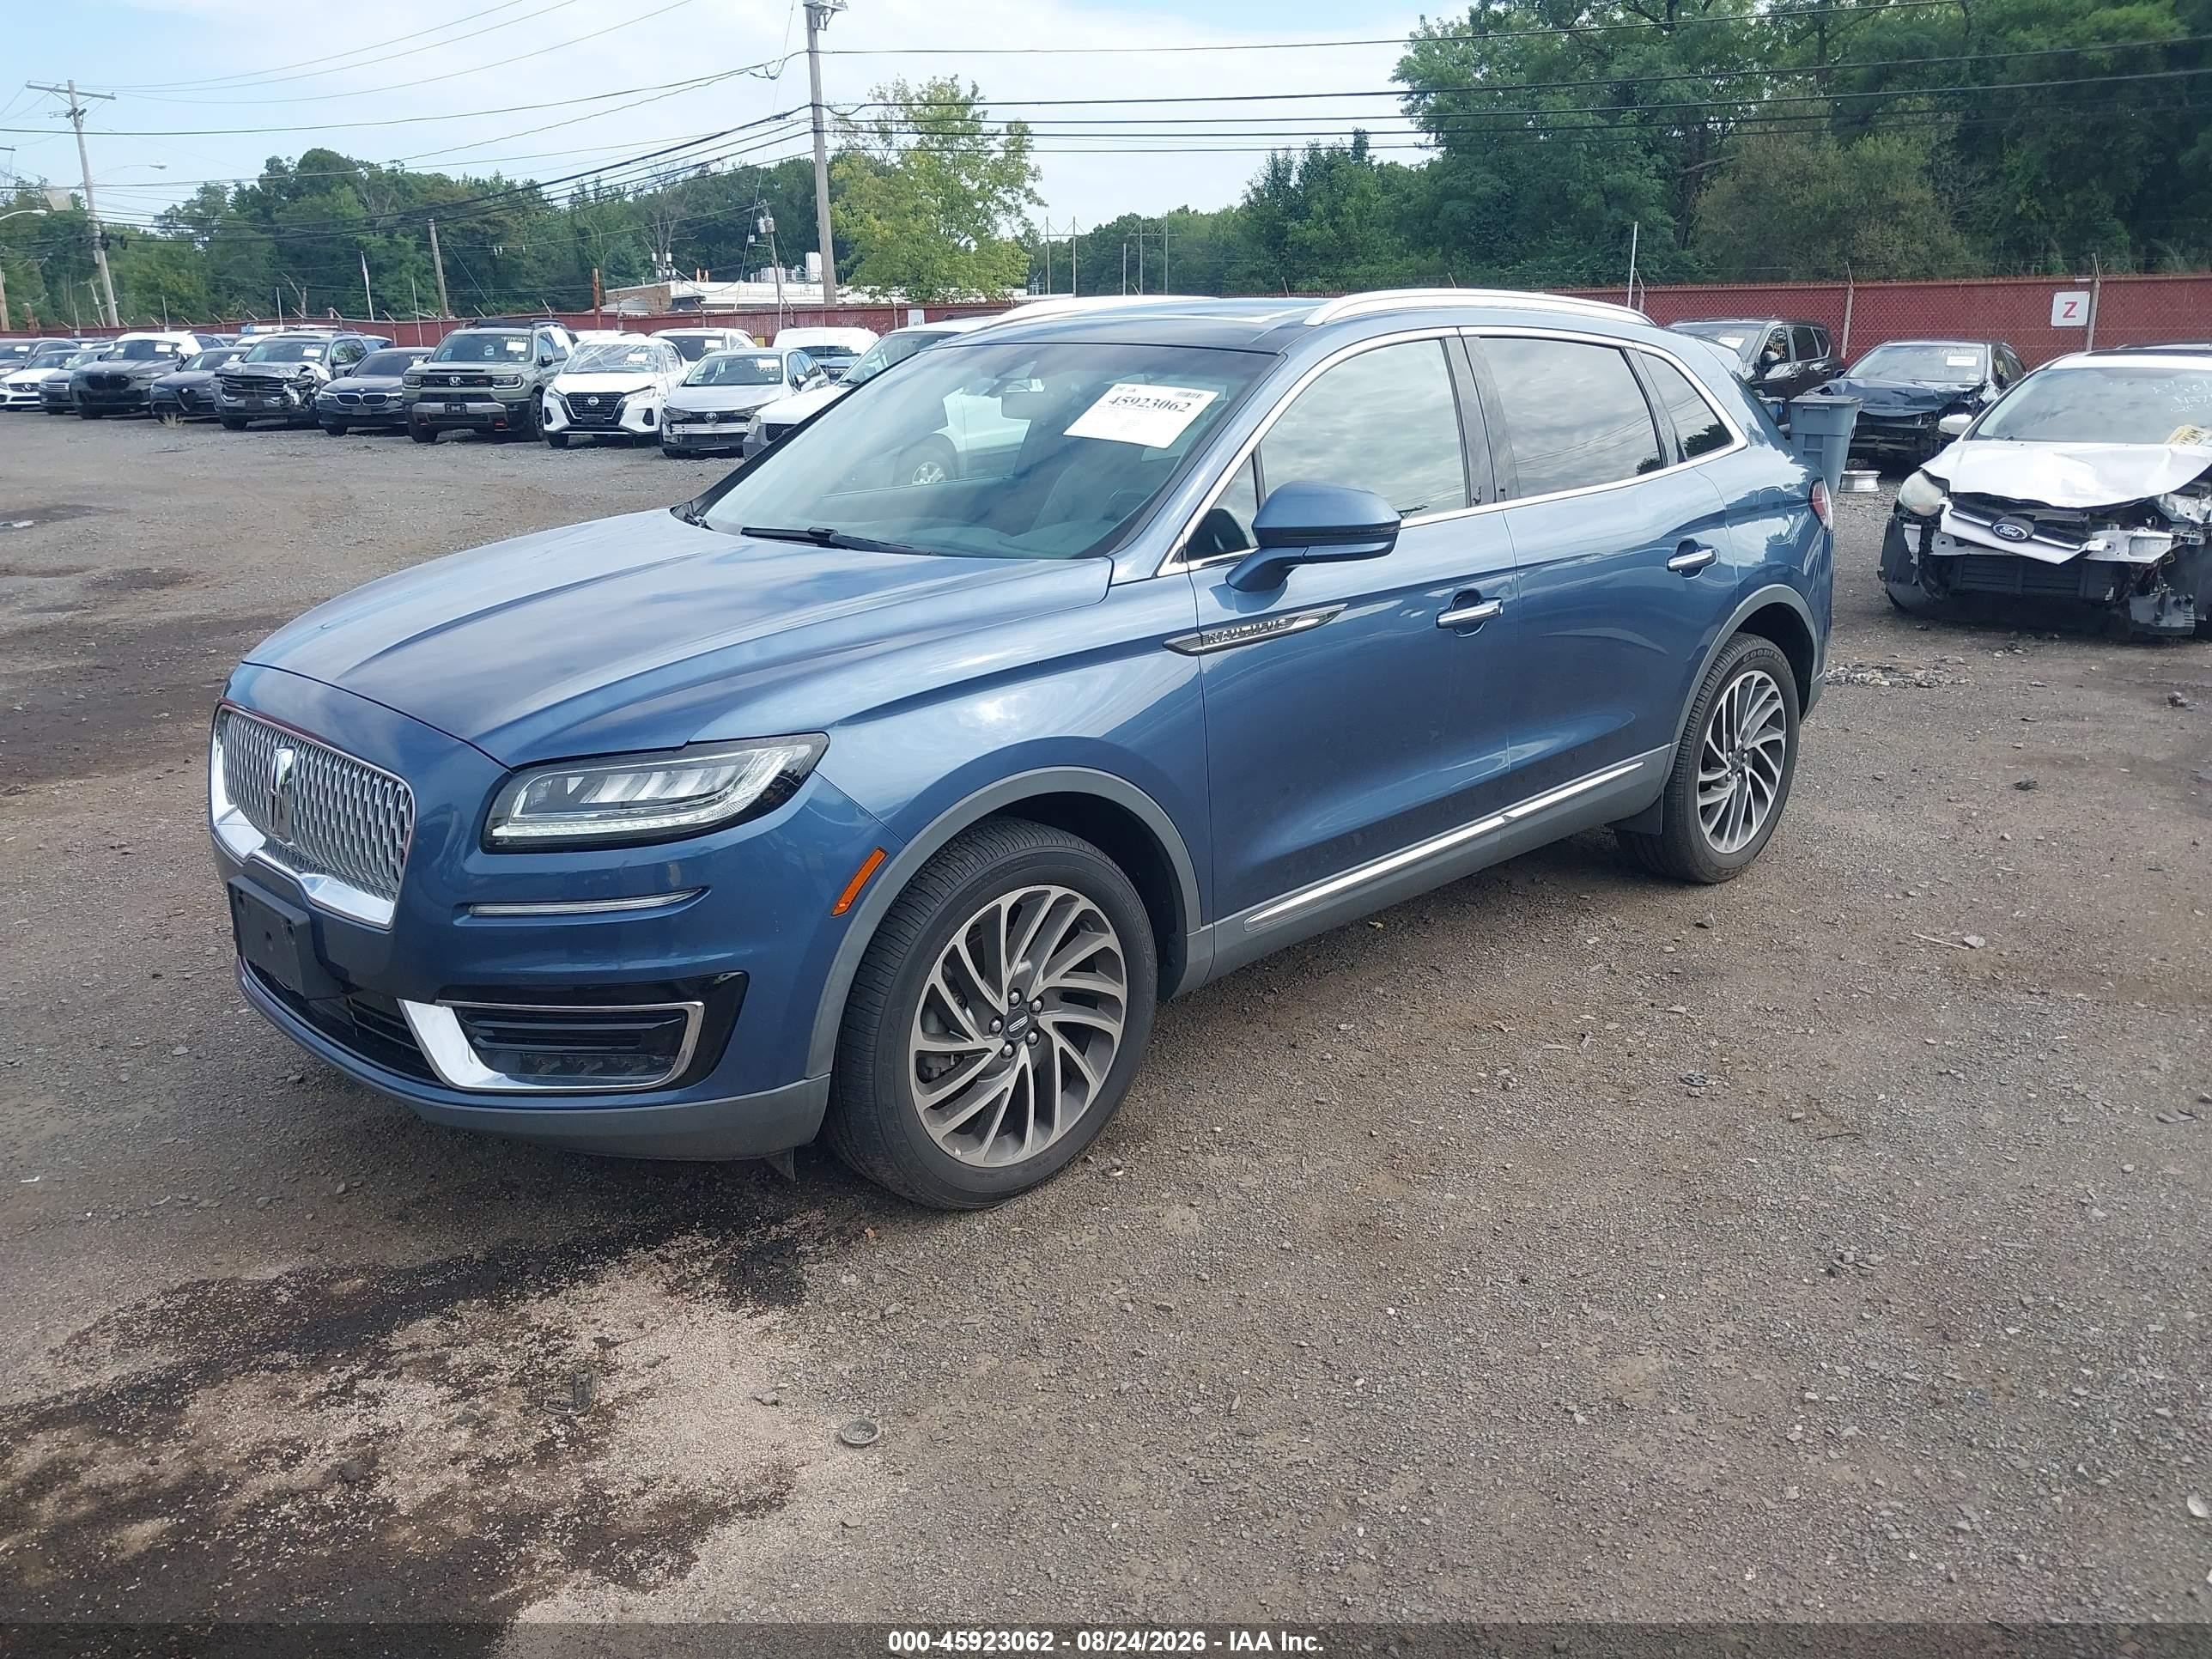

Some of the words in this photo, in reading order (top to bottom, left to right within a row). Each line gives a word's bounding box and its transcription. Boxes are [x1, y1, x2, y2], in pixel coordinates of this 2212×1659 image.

[2063, 301, 2078, 319] Z
[1109, 395, 1192, 412] 45923062
[1999, 526, 2020, 537] Ford
